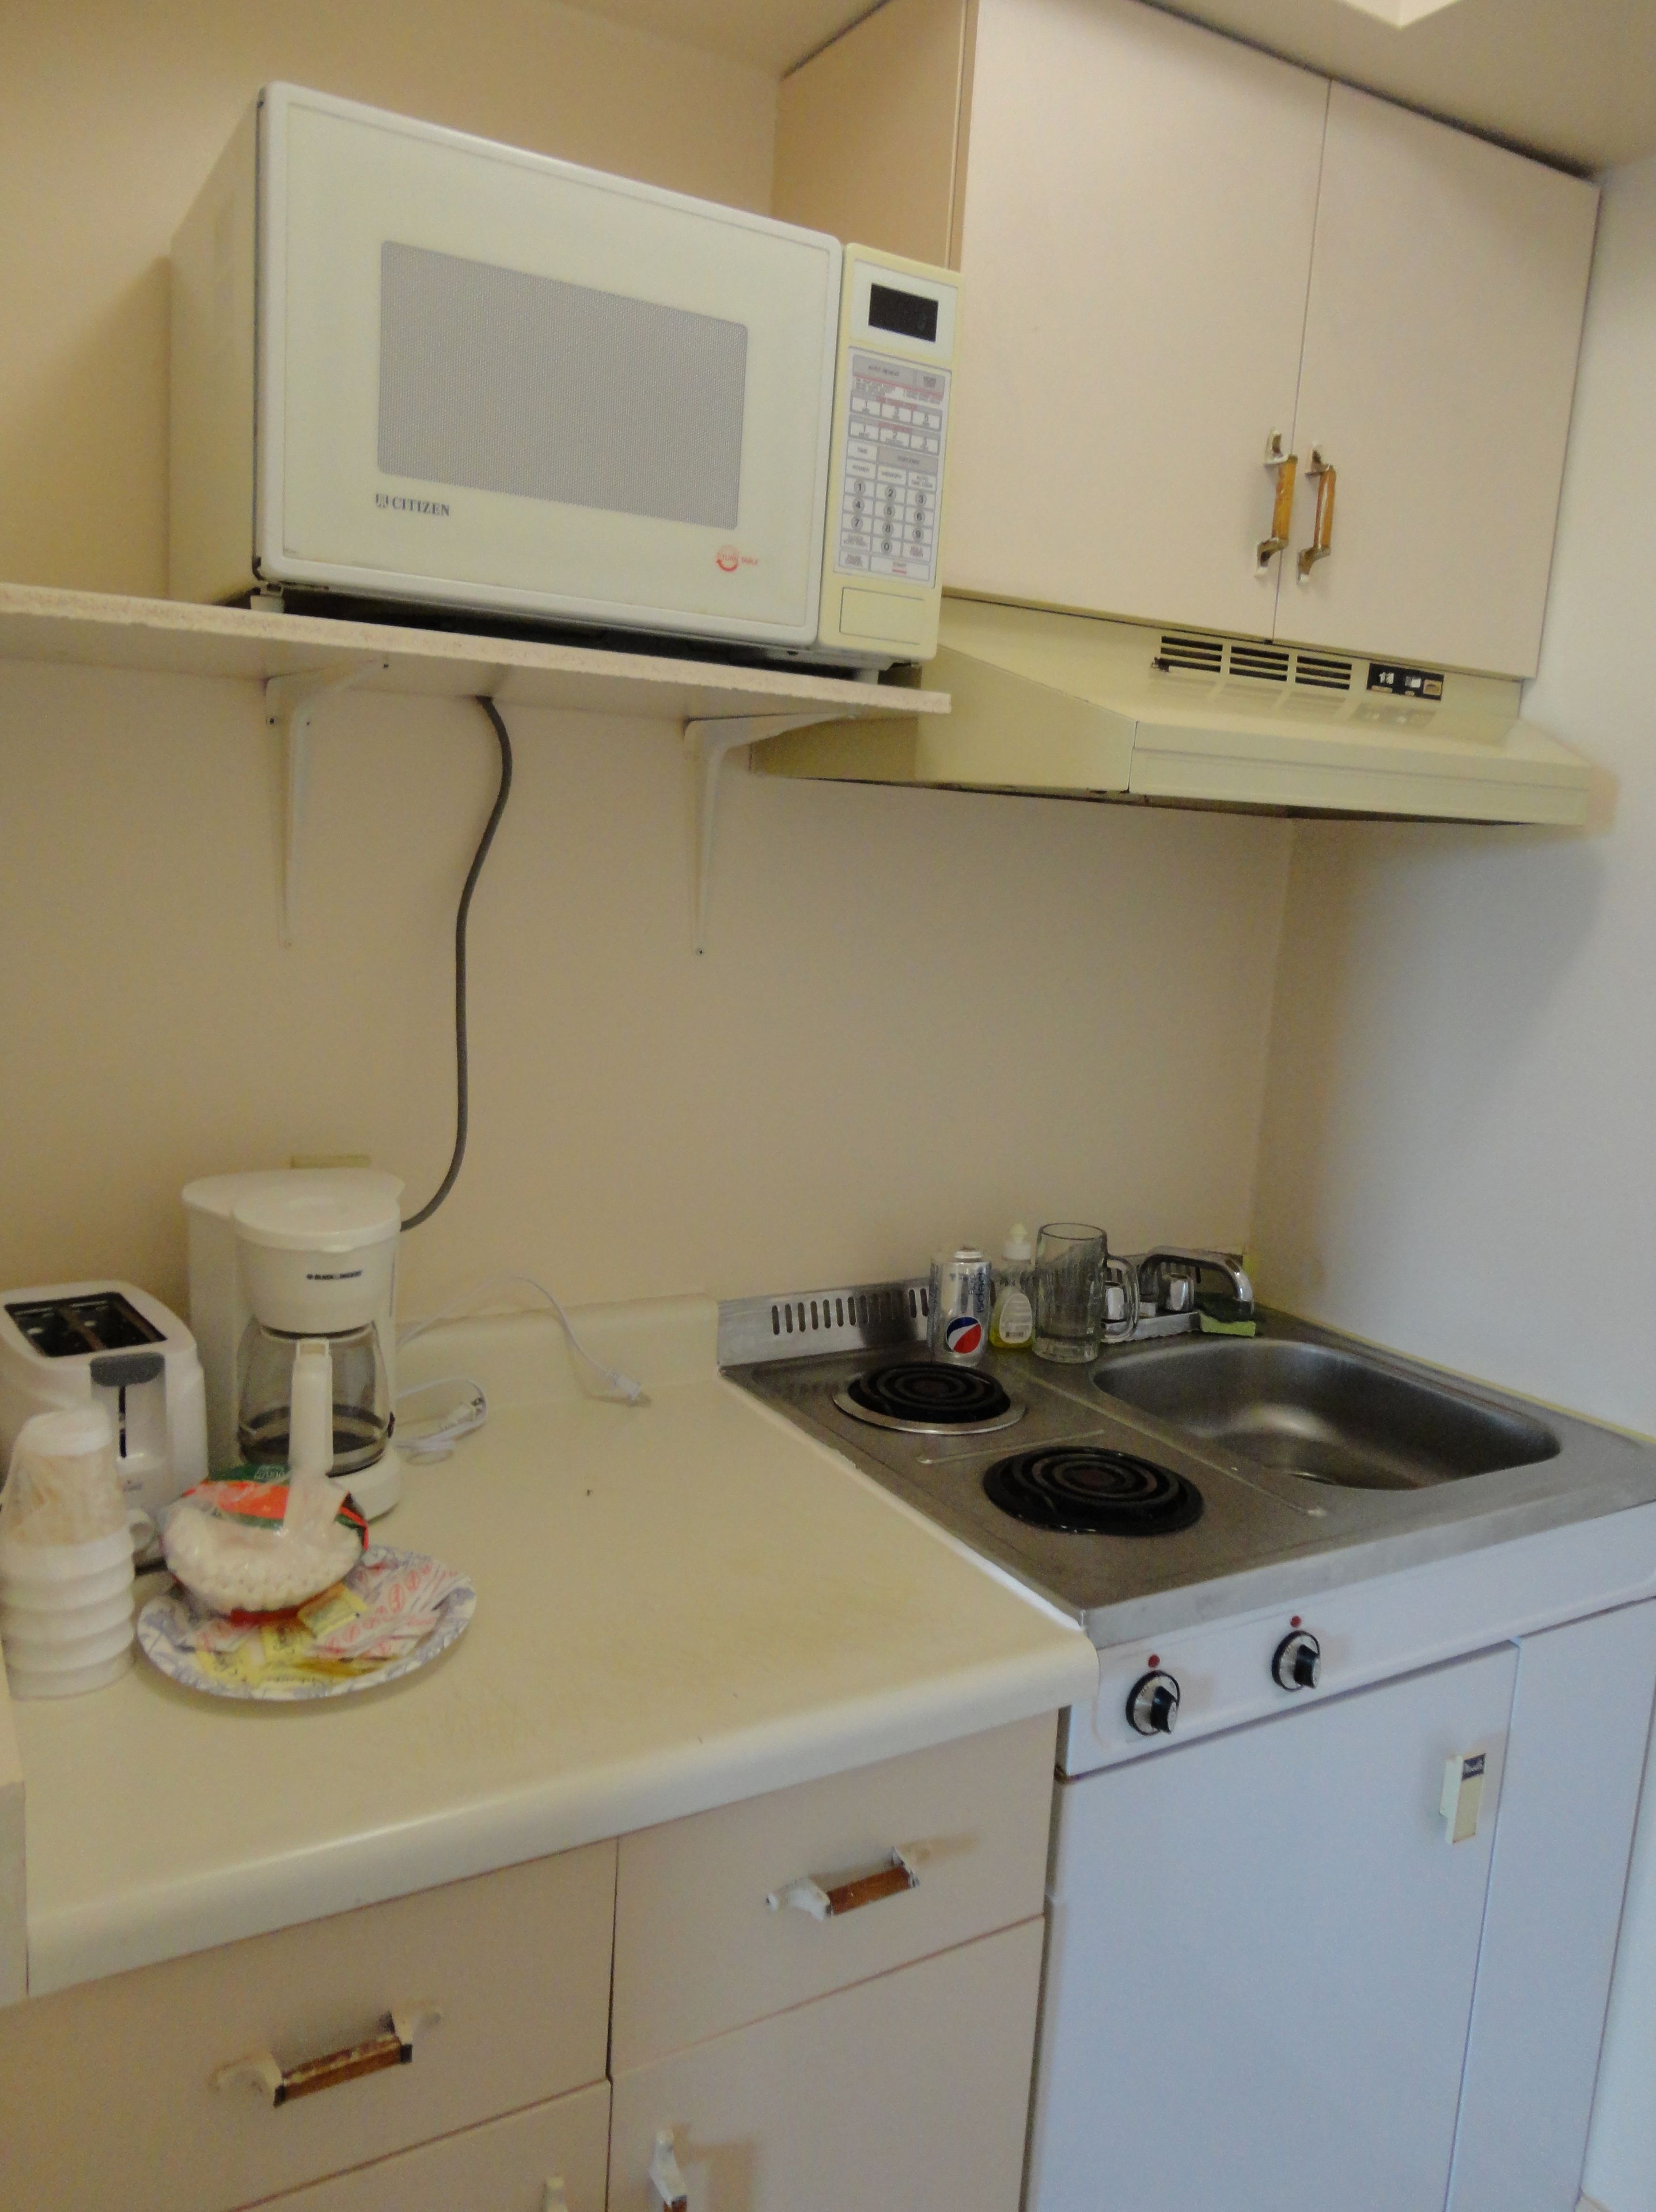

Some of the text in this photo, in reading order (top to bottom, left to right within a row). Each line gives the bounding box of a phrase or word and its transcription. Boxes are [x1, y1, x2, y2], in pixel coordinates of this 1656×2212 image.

[858, 483, 862, 491] 1
[888, 489, 893, 497] 2
[918, 494, 924, 503] 3
[392, 494, 450, 517] CITIZEN
[855, 501, 861, 509] 4
[886, 506, 892, 515] 5
[916, 513, 922, 521] 6
[855, 518, 860, 527] 7
[885, 524, 891, 533] 8
[915, 531, 921, 539] 9
[884, 542, 890, 551] 0
[976, 1272, 986, 1313] pepsi
